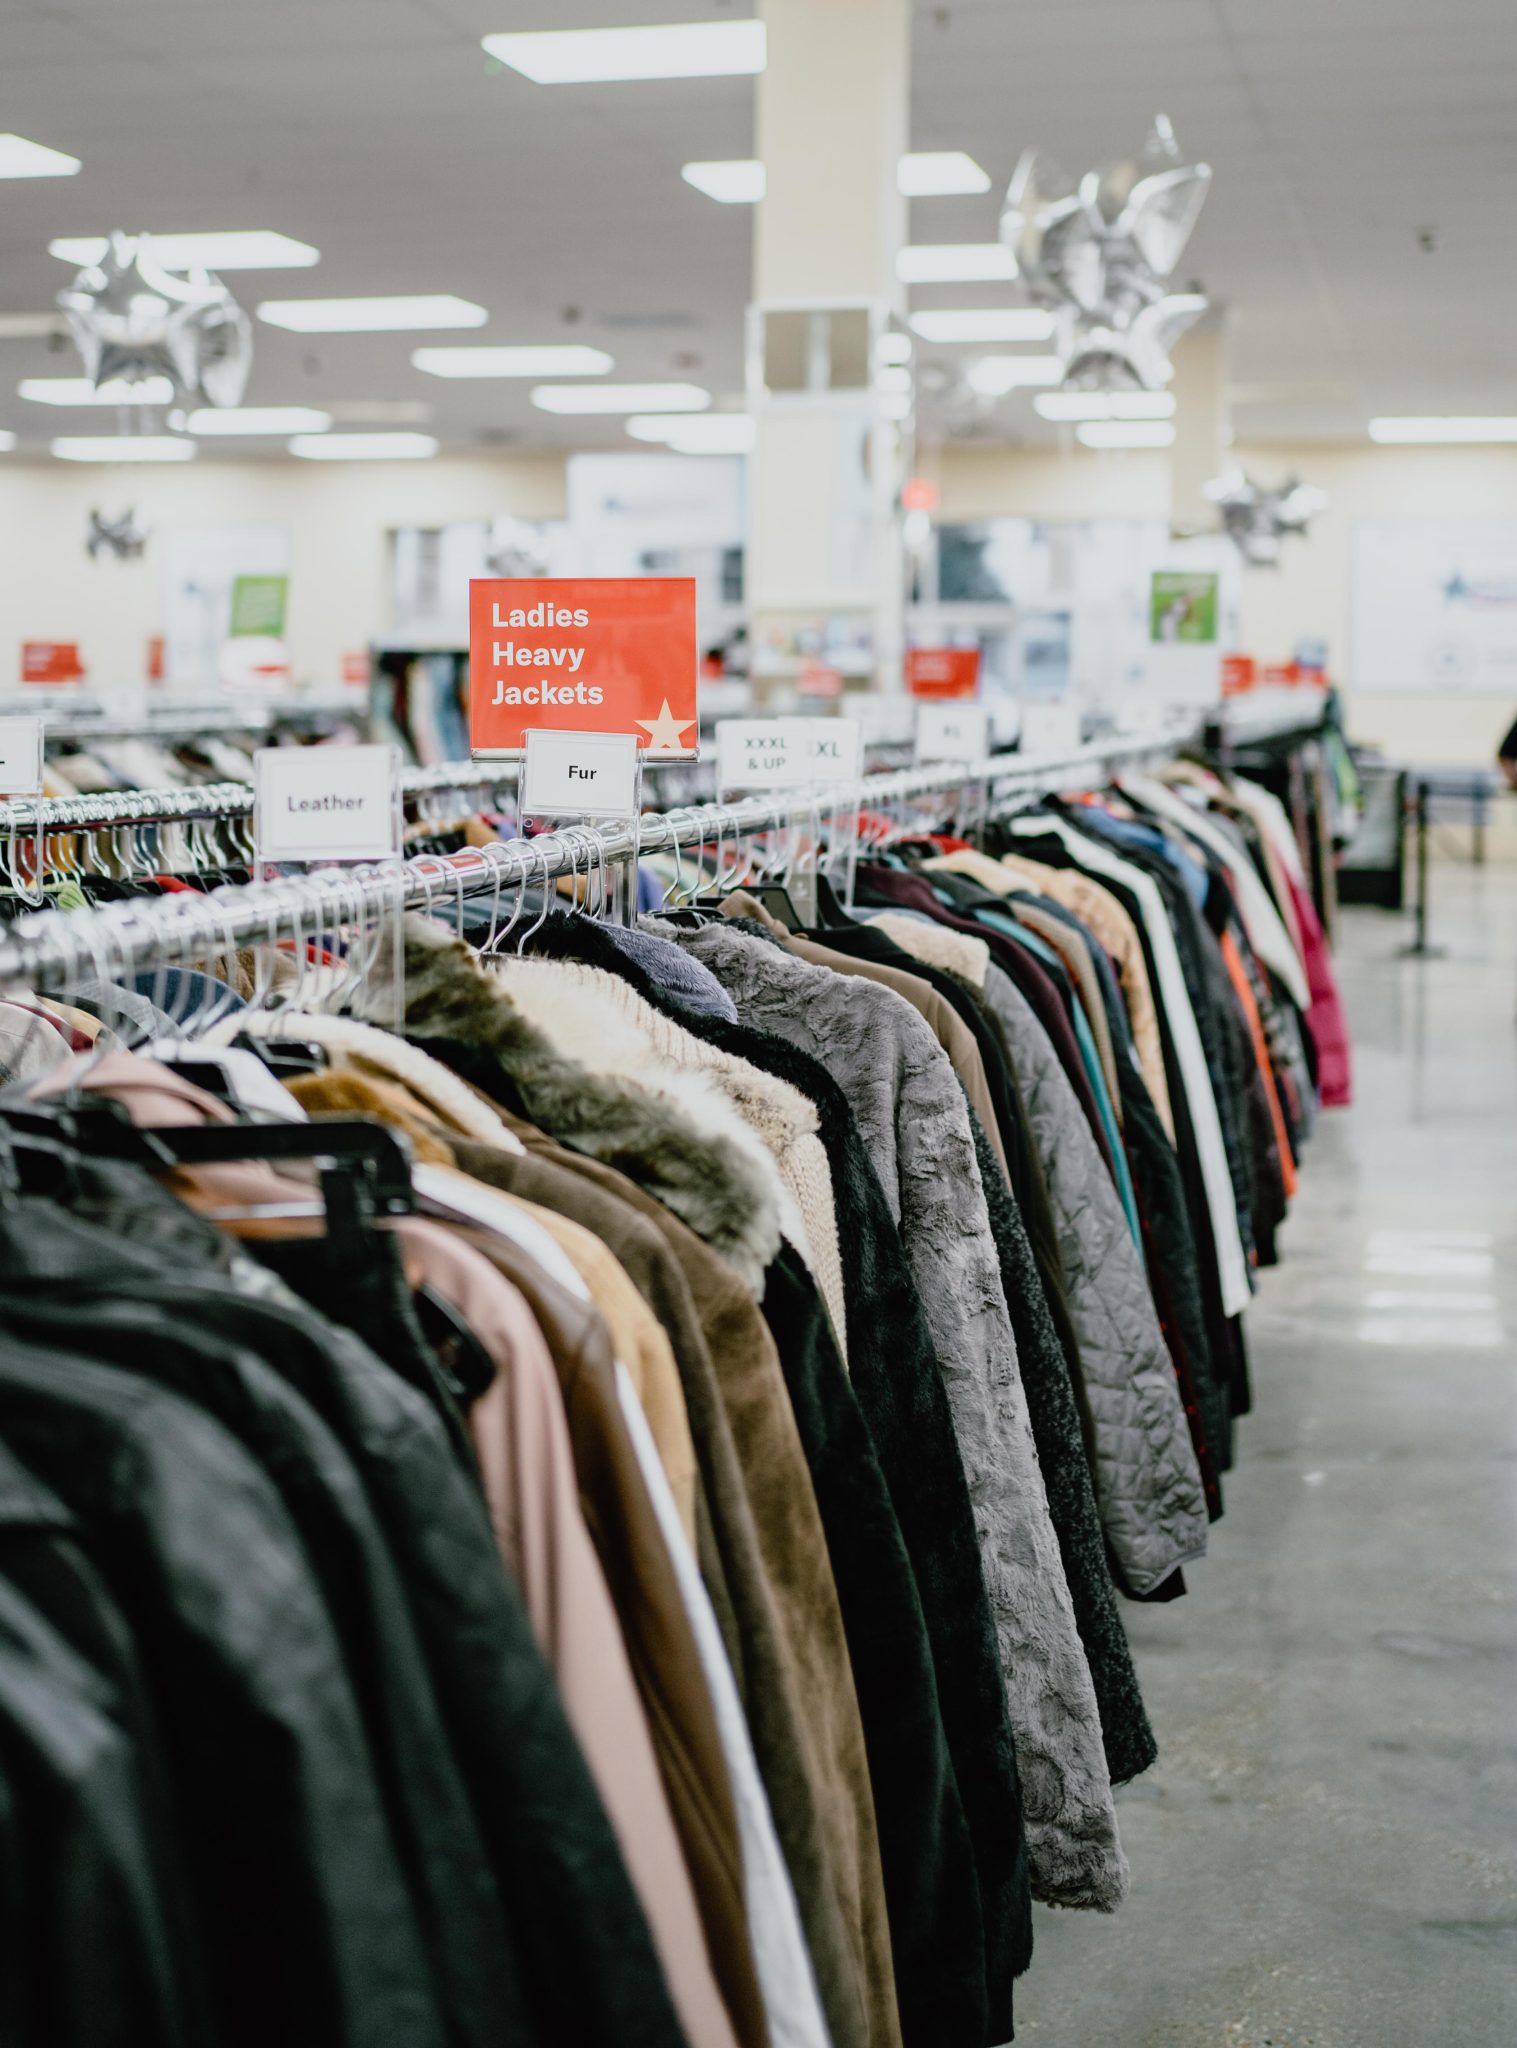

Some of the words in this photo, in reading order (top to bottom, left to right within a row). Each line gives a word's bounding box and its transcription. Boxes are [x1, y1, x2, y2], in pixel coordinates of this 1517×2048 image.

[492, 602, 589, 628] Ladies
[492, 641, 585, 672] Heavy
[491, 679, 604, 705] Jackets
[745, 737, 788, 750] XXXL
[568, 765, 598, 780] Fur
[748, 757, 759, 770] &
[763, 757, 787, 770] UP
[288, 794, 365, 813] Leather
